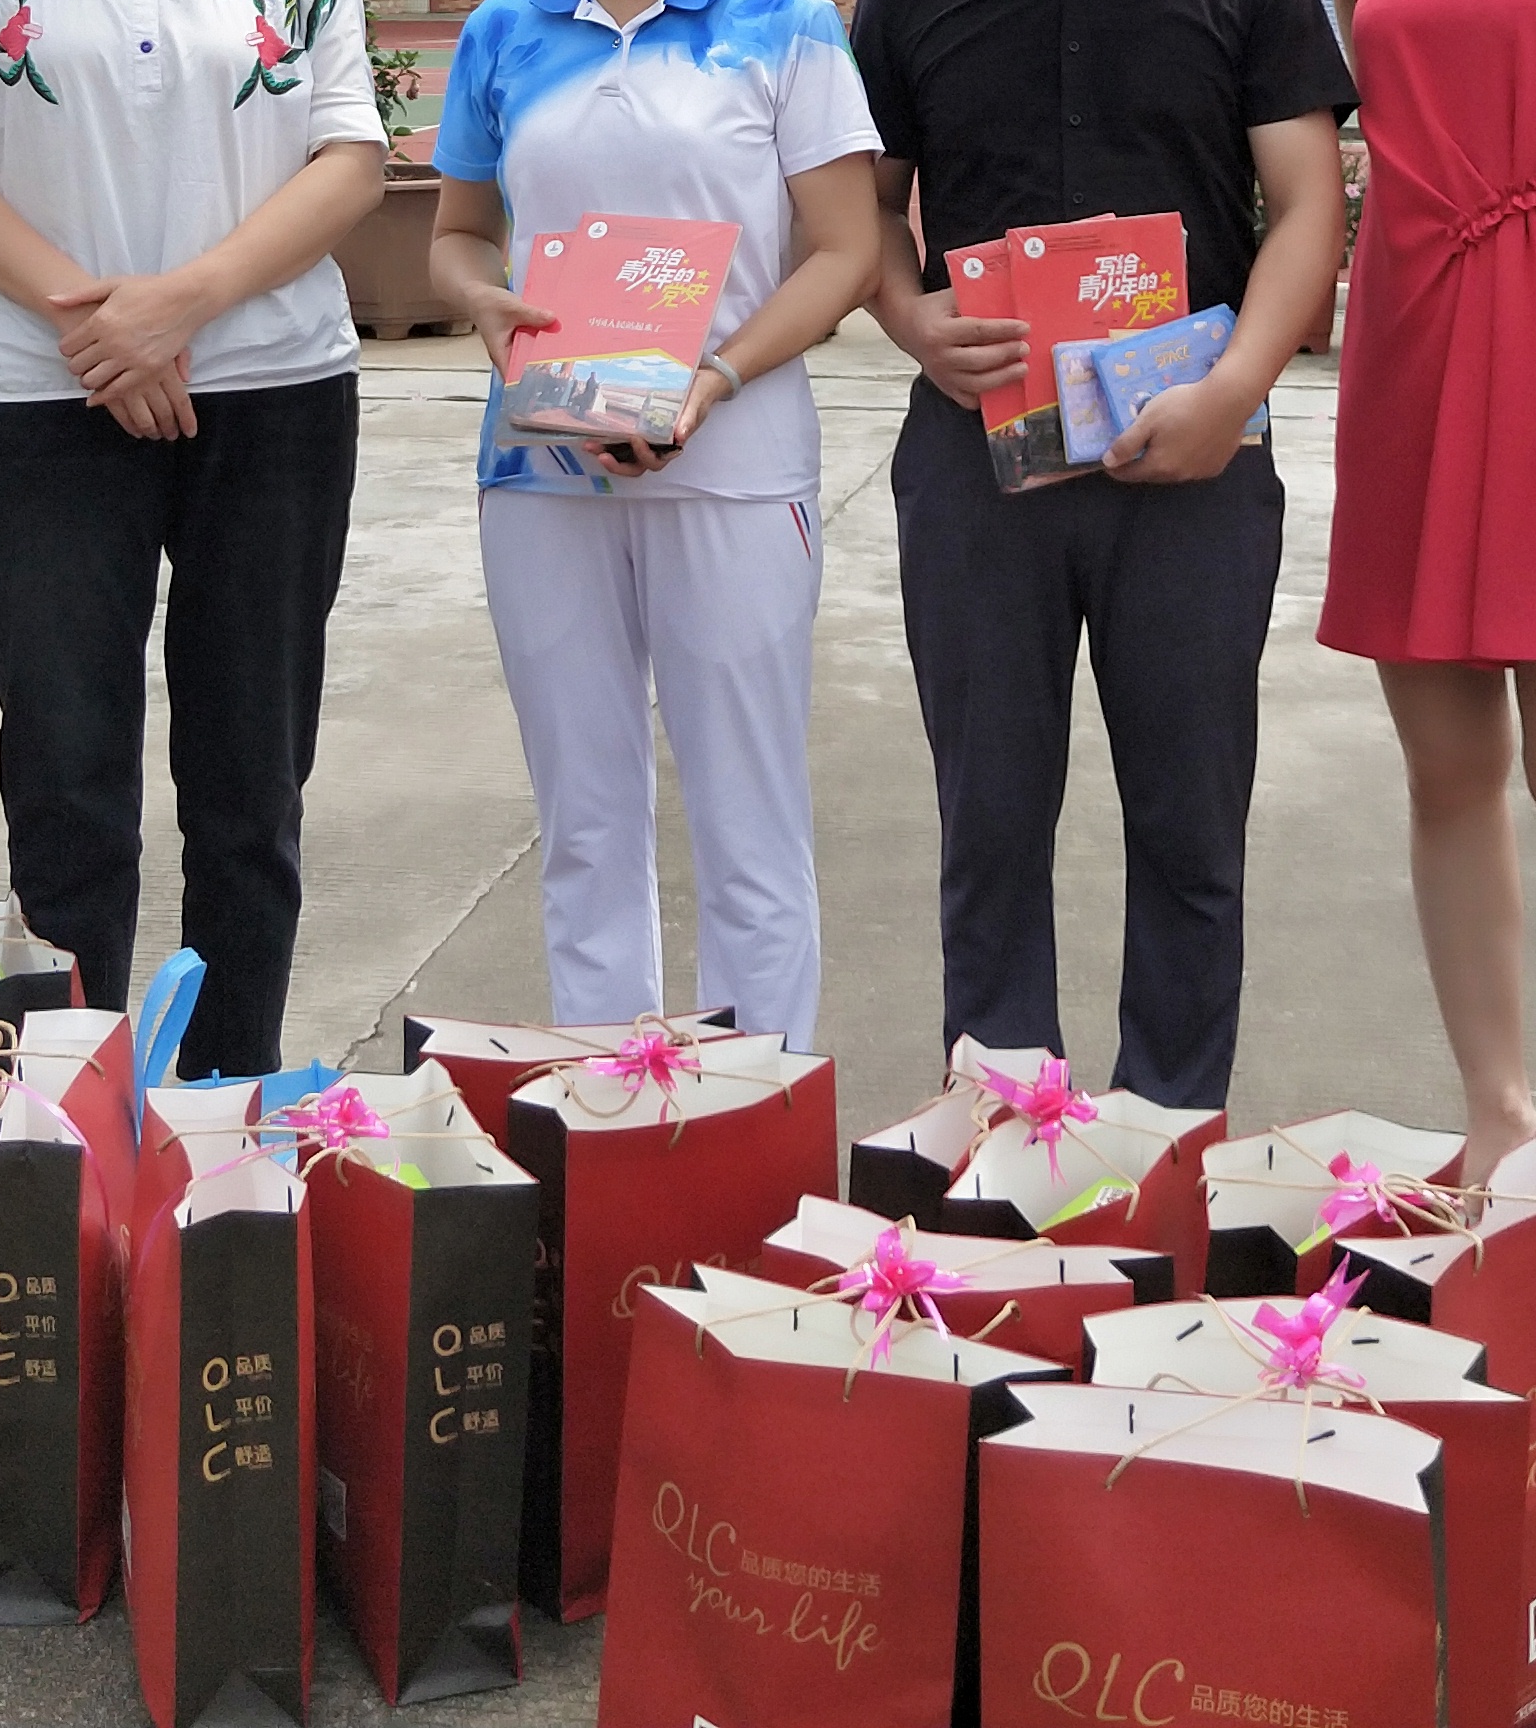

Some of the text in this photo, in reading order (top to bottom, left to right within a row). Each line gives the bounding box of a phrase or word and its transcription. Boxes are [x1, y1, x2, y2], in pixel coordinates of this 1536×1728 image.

[642, 246, 686, 266] 写给
[1095, 253, 1141, 276] 写给
[616, 260, 696, 291] 青少年的
[1077, 272, 1158, 311] 青少年的
[647, 283, 710, 311] 党史
[1125, 286, 1178, 328] 党史
[24, 1315, 56, 1333] 平价
[433, 1324, 463, 1357] Q
[202, 1357, 231, 1392] Q
[435, 1363, 503, 1396] L 平价
[205, 1395, 272, 1432] L 平价
[430, 1407, 458, 1444] C
[202, 1441, 232, 1482] C
[652, 1481, 882, 1598] QLC 品质您的生活
[686, 1571, 884, 1672] your life
[1032, 1640, 1349, 1728] QLC 品质您的生活
